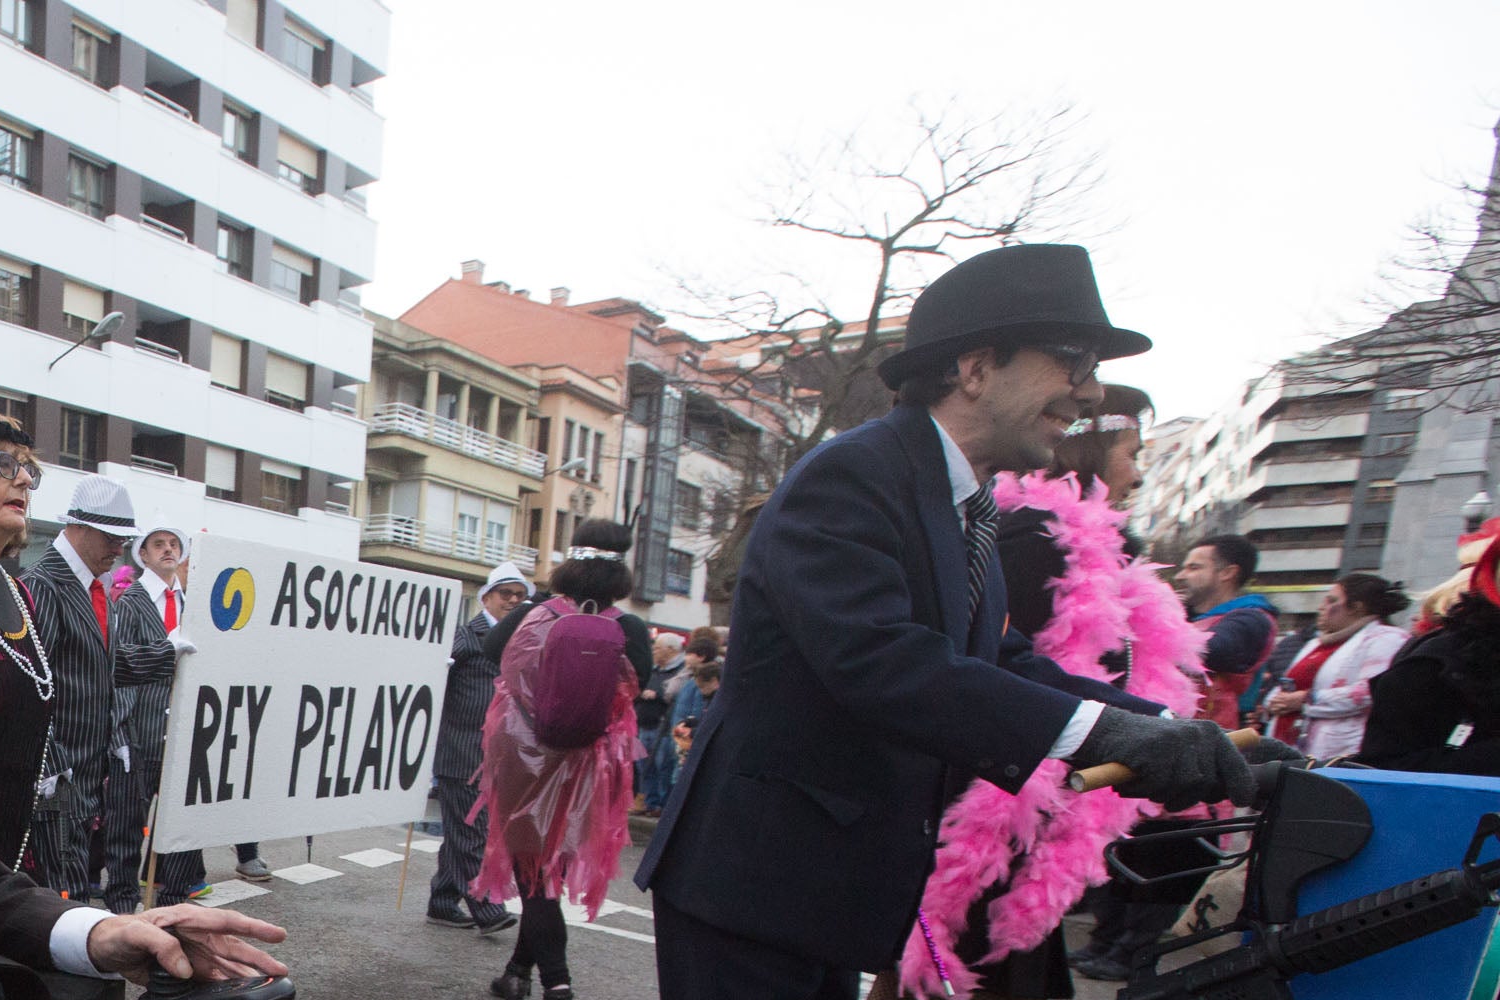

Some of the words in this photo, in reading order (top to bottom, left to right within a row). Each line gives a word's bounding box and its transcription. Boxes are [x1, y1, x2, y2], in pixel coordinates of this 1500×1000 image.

[270, 561, 451, 645] ASOCIACION
[185, 684, 272, 806] REY
[288, 684, 433, 799] PELAYO
